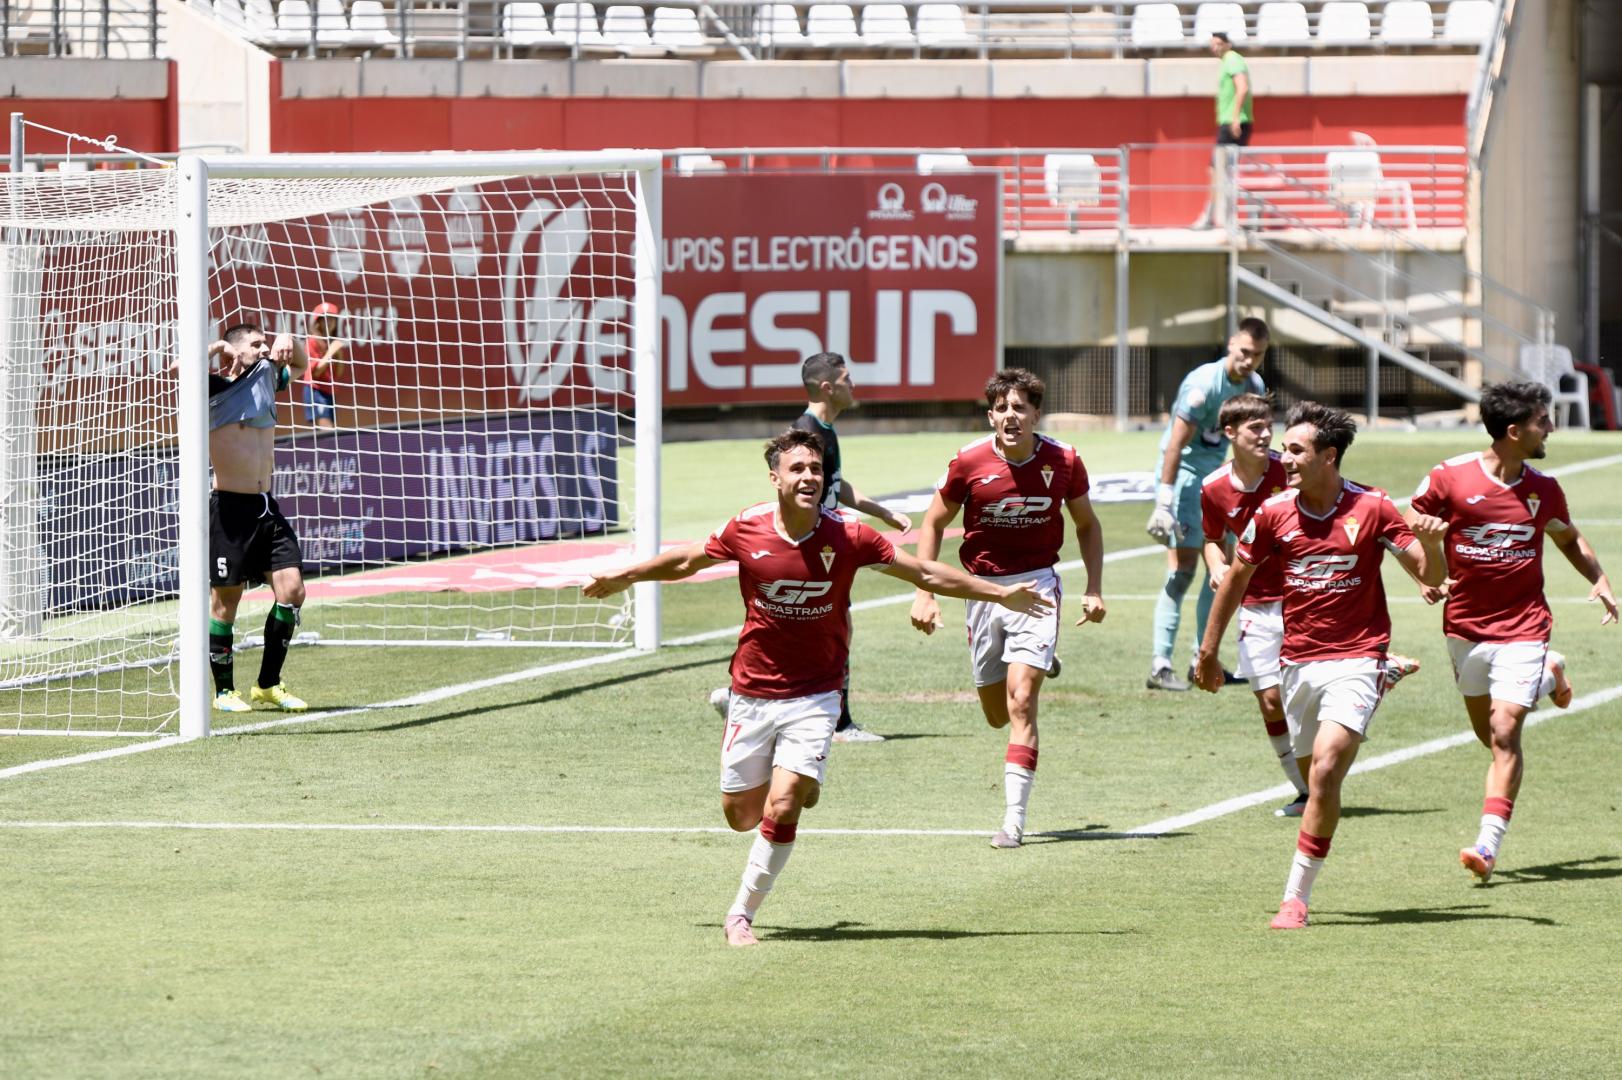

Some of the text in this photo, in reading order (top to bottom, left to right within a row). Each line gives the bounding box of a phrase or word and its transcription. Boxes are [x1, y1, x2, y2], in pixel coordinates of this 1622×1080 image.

[732, 227, 978, 272] ELECTRÓGENOS
[1468, 523, 1536, 547] GP
[217, 557, 229, 578] 5
[764, 580, 833, 605] GP
[726, 723, 743, 753] 7
